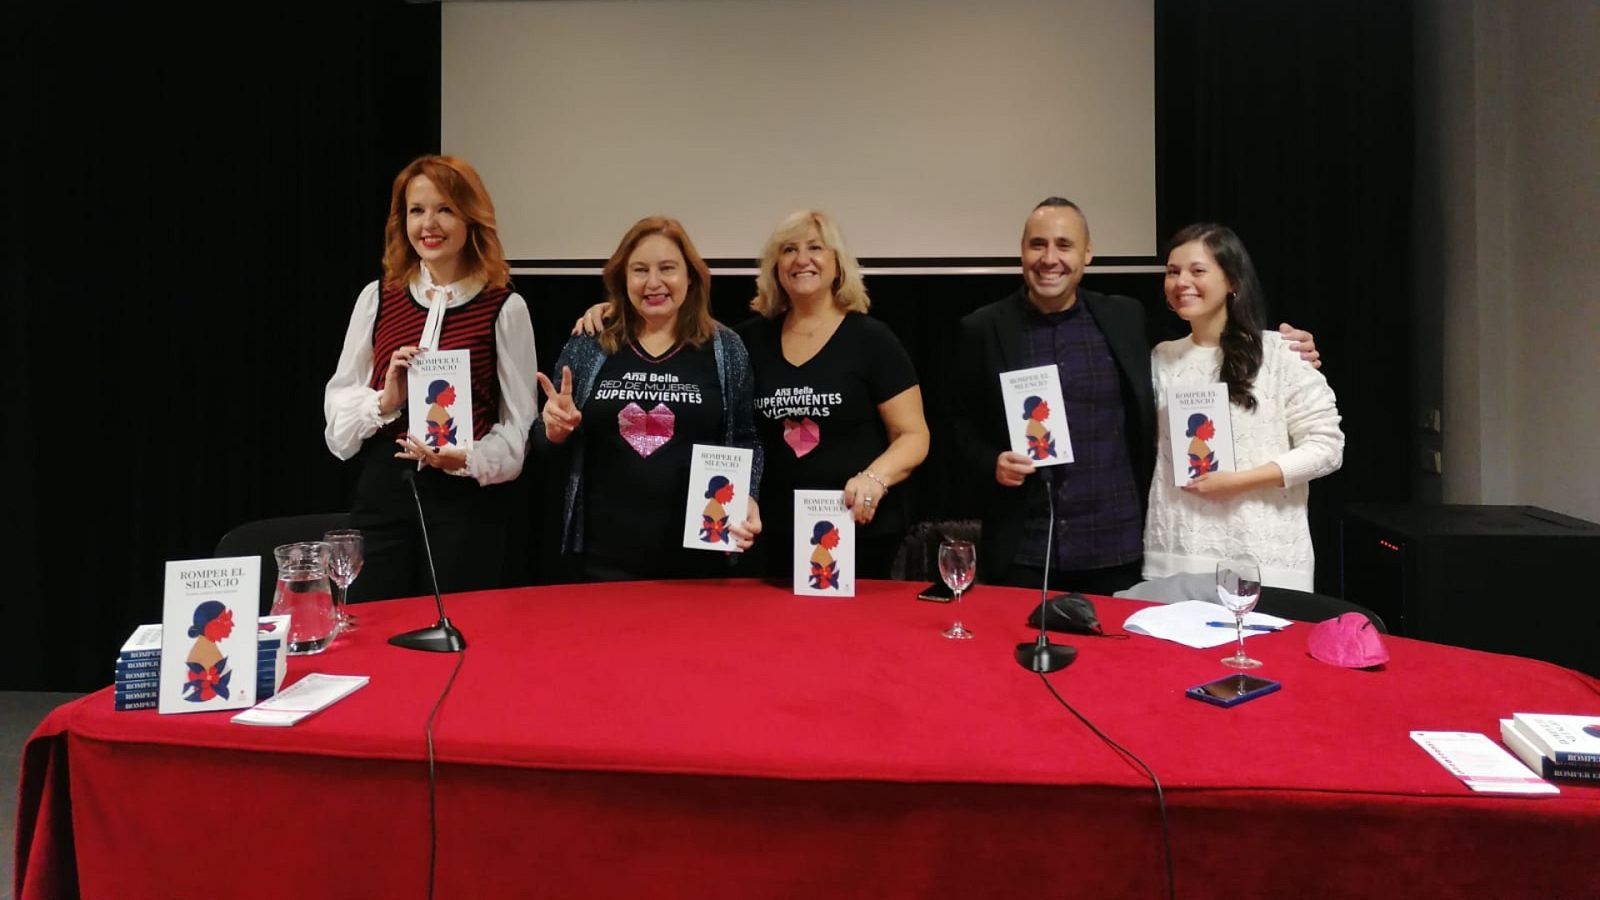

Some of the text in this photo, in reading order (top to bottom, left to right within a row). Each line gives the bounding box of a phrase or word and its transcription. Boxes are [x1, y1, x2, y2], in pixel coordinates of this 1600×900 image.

[650, 373, 679, 382] Bella
[600, 380, 700, 392] RED DE MUJERES
[794, 386, 814, 396] Bella
[594, 389, 702, 404] SUPERVIVIENTES
[704, 460, 740, 468] SILENCIO
[180, 568, 245, 580] ROMPER EL
[186, 578, 239, 589] SILENCIO
[128, 661, 160, 669] ROMPER
[126, 671, 156, 680] ROMPER
[126, 682, 157, 690] ROMPER
[126, 692, 156, 700] ROMPER
